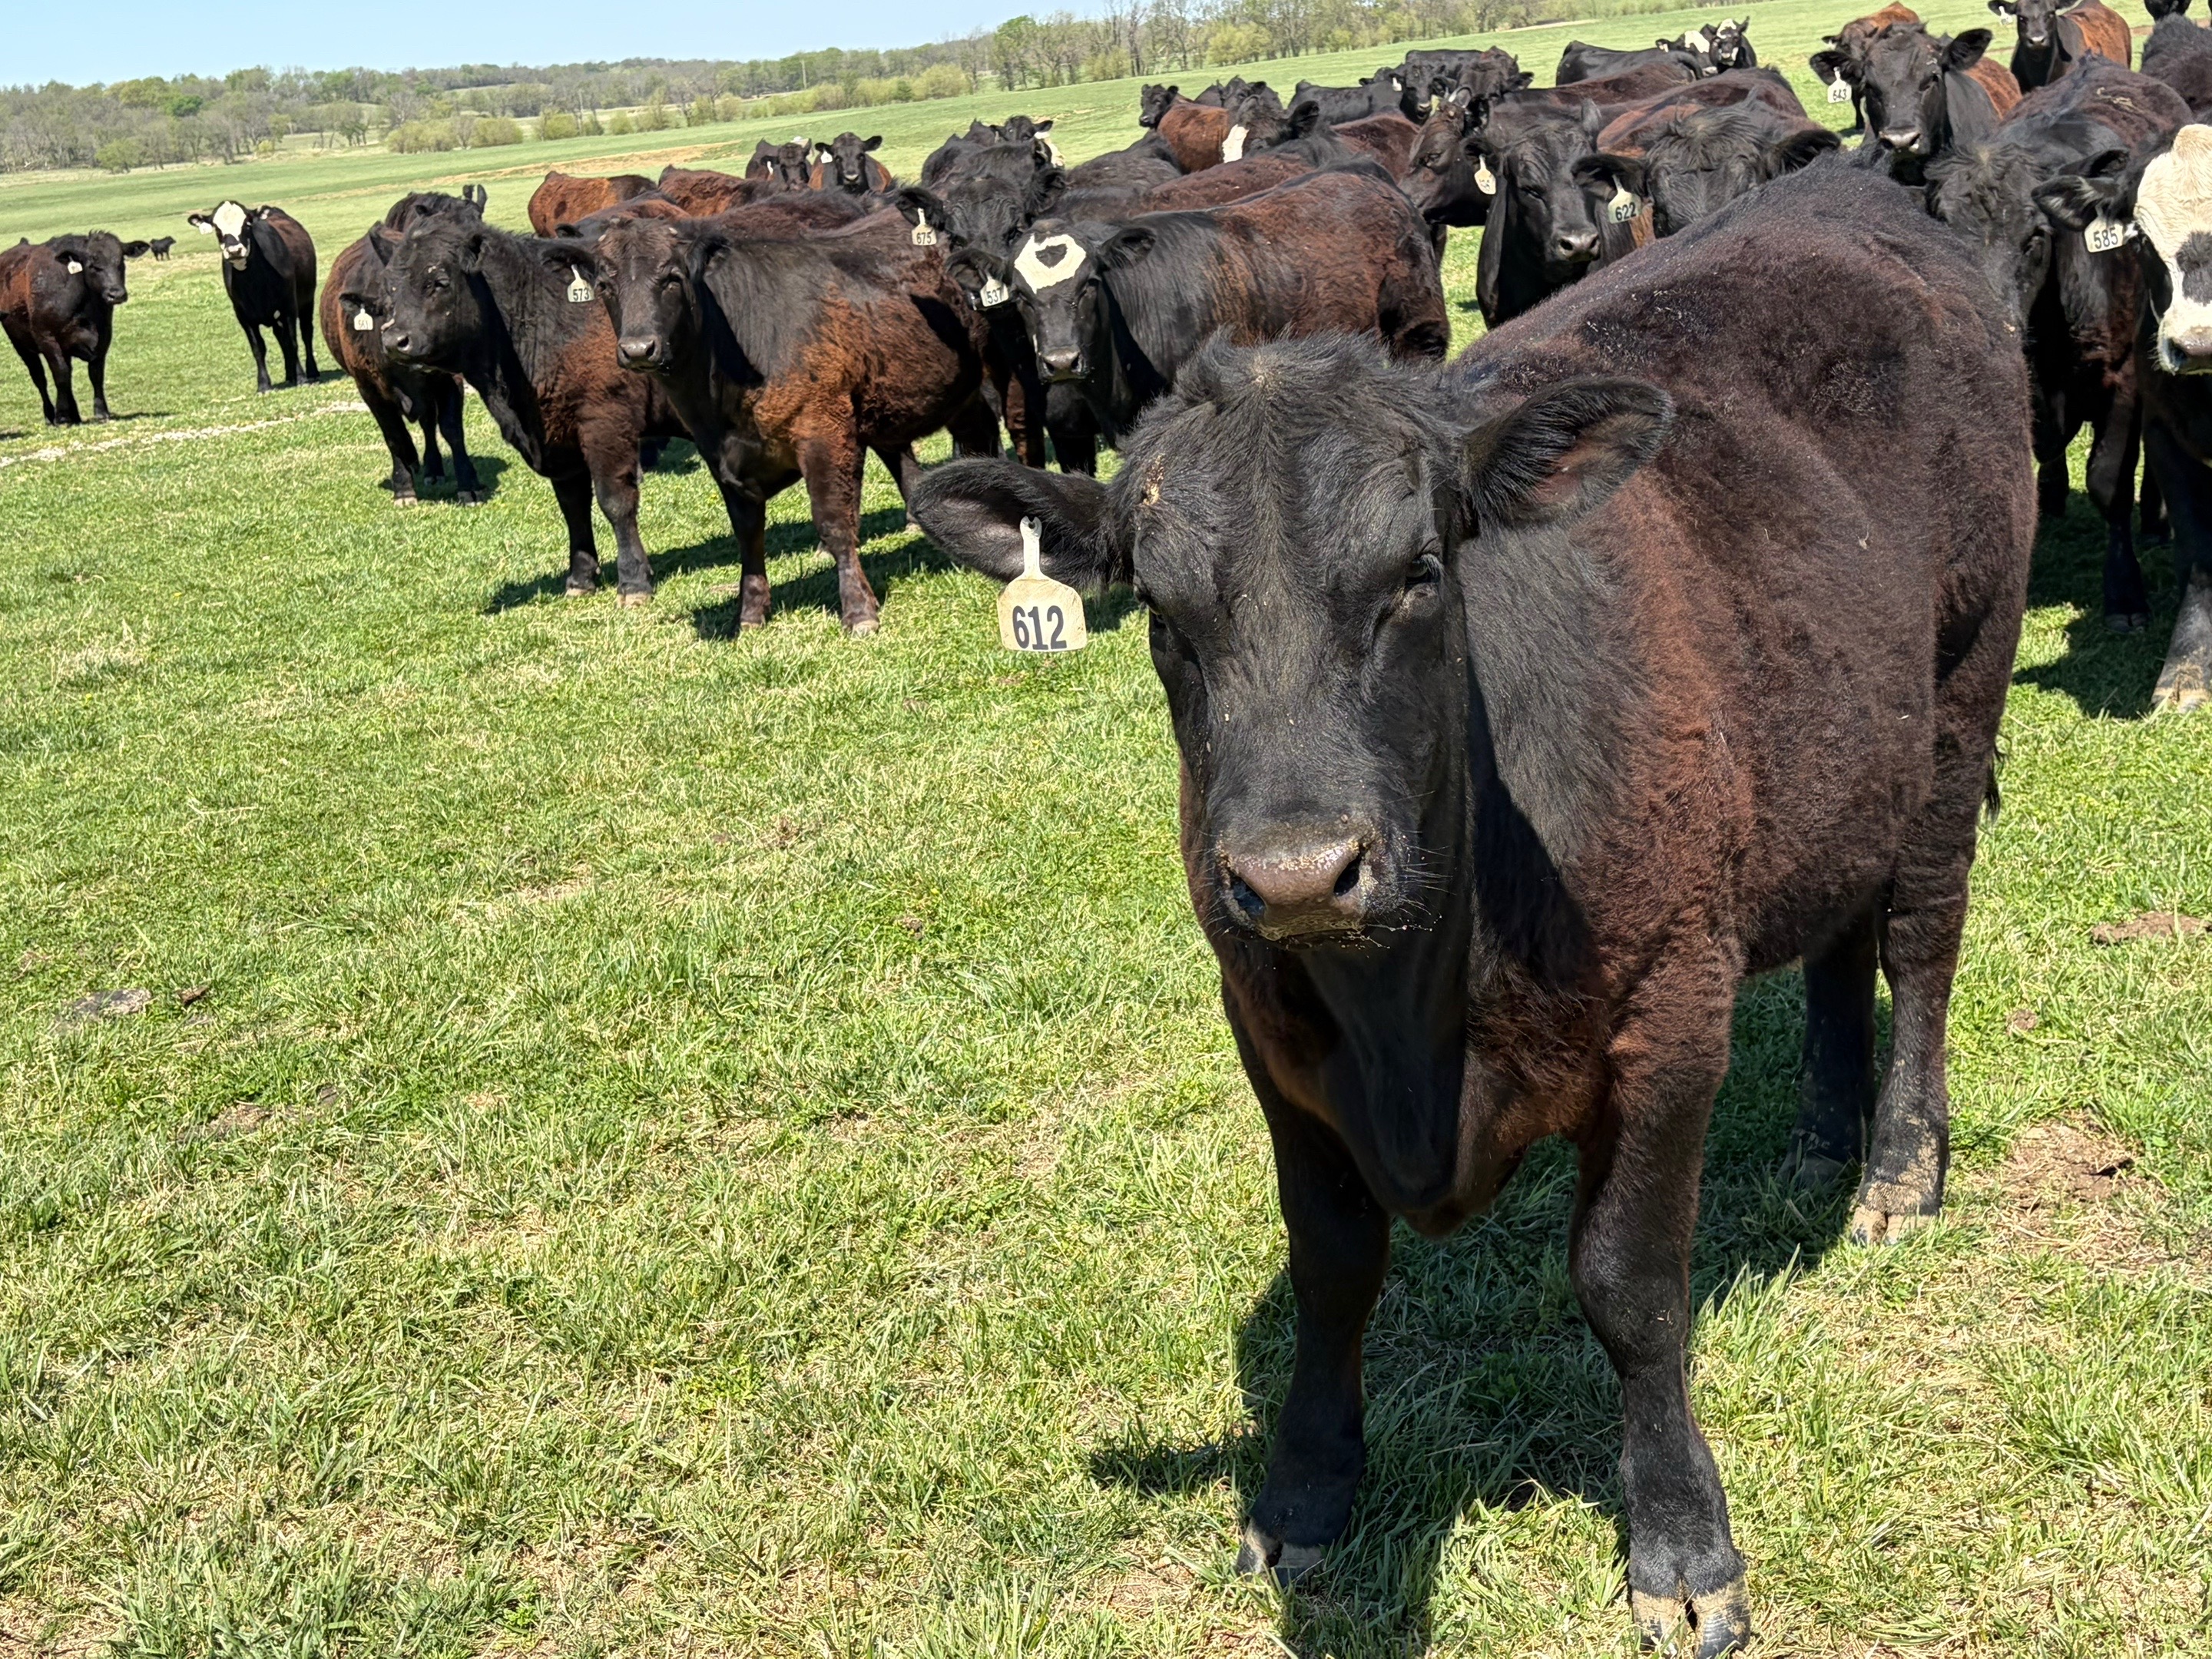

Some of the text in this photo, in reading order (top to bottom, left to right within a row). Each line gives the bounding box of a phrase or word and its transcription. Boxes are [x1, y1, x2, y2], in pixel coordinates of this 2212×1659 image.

[1616, 202, 1636, 220] 622
[917, 233, 932, 243] 675
[2093, 227, 2118, 249] 585
[573, 289, 589, 301] 573
[987, 288, 1002, 304] 537
[1012, 605, 1068, 650] 612
